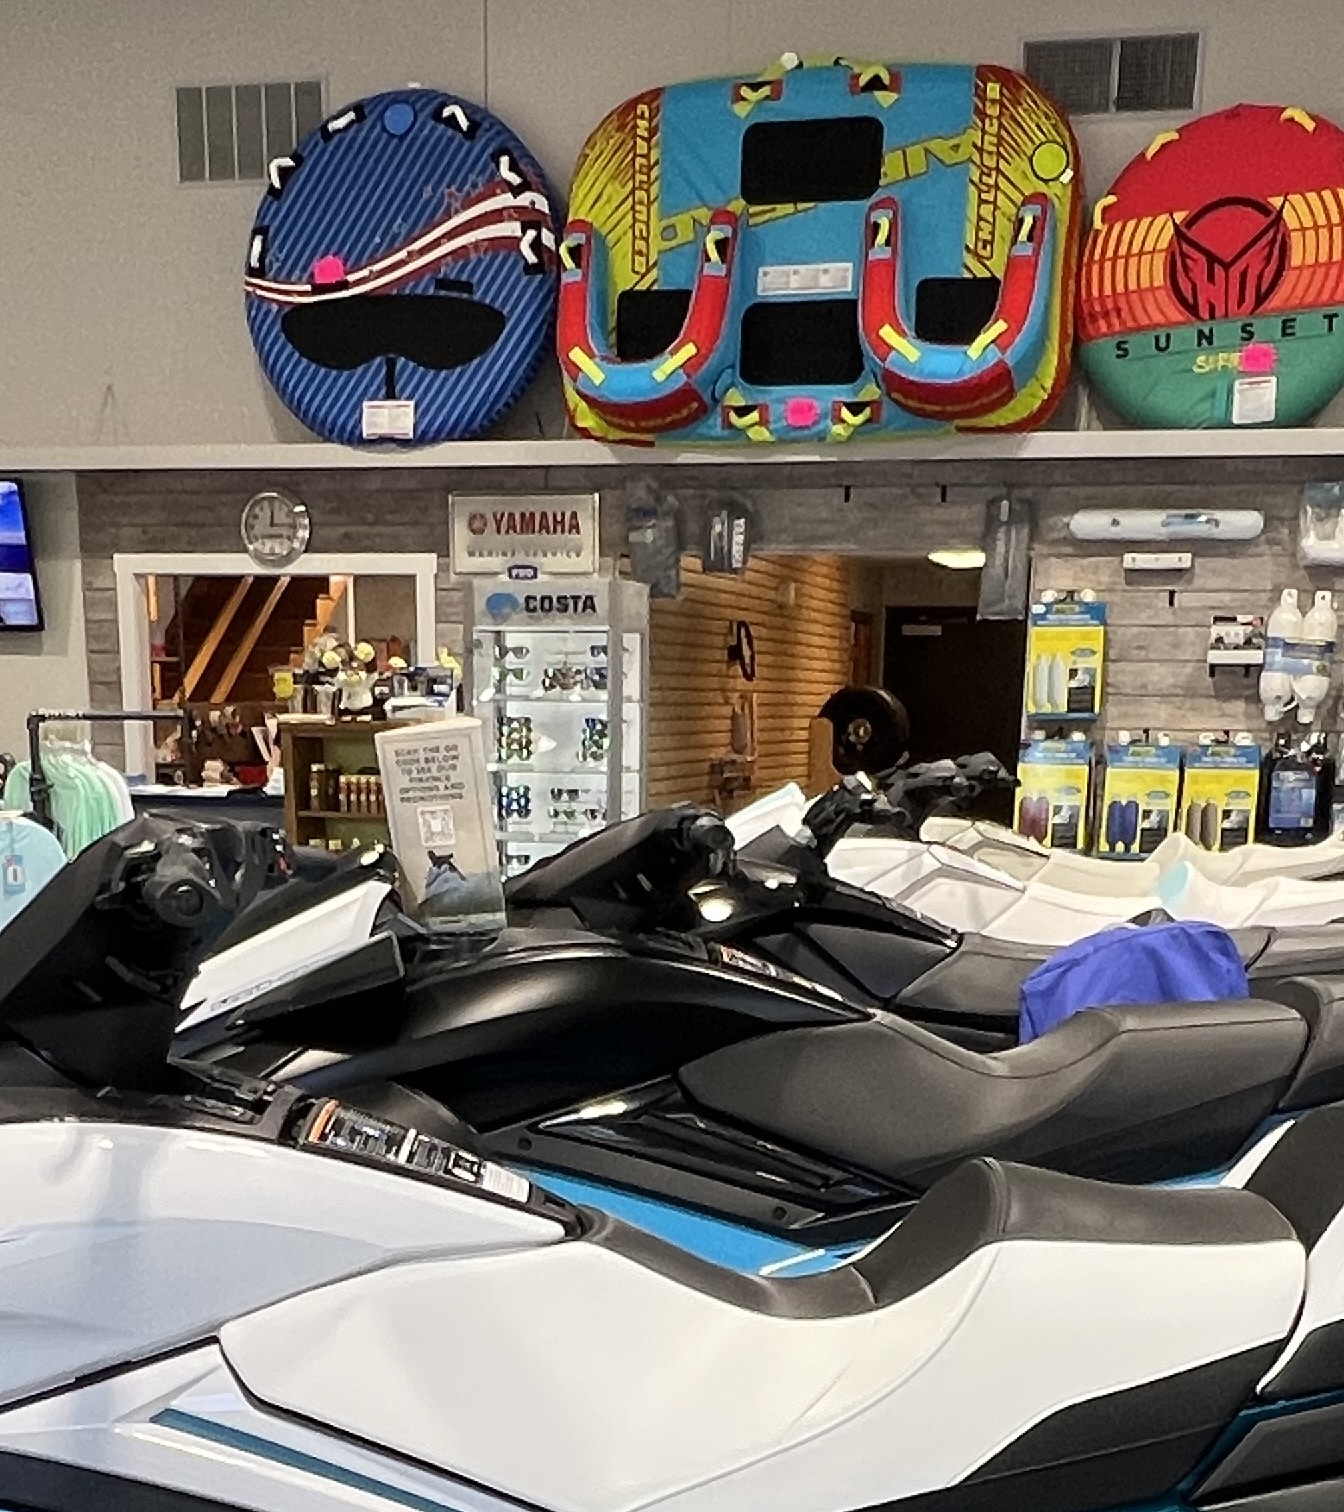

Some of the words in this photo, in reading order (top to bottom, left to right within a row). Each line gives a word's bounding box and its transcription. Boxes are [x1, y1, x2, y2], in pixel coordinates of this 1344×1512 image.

[1114, 312, 1340, 360] SUNSET
[492, 511, 582, 536] YAMAHA
[524, 594, 598, 614] COSTA
